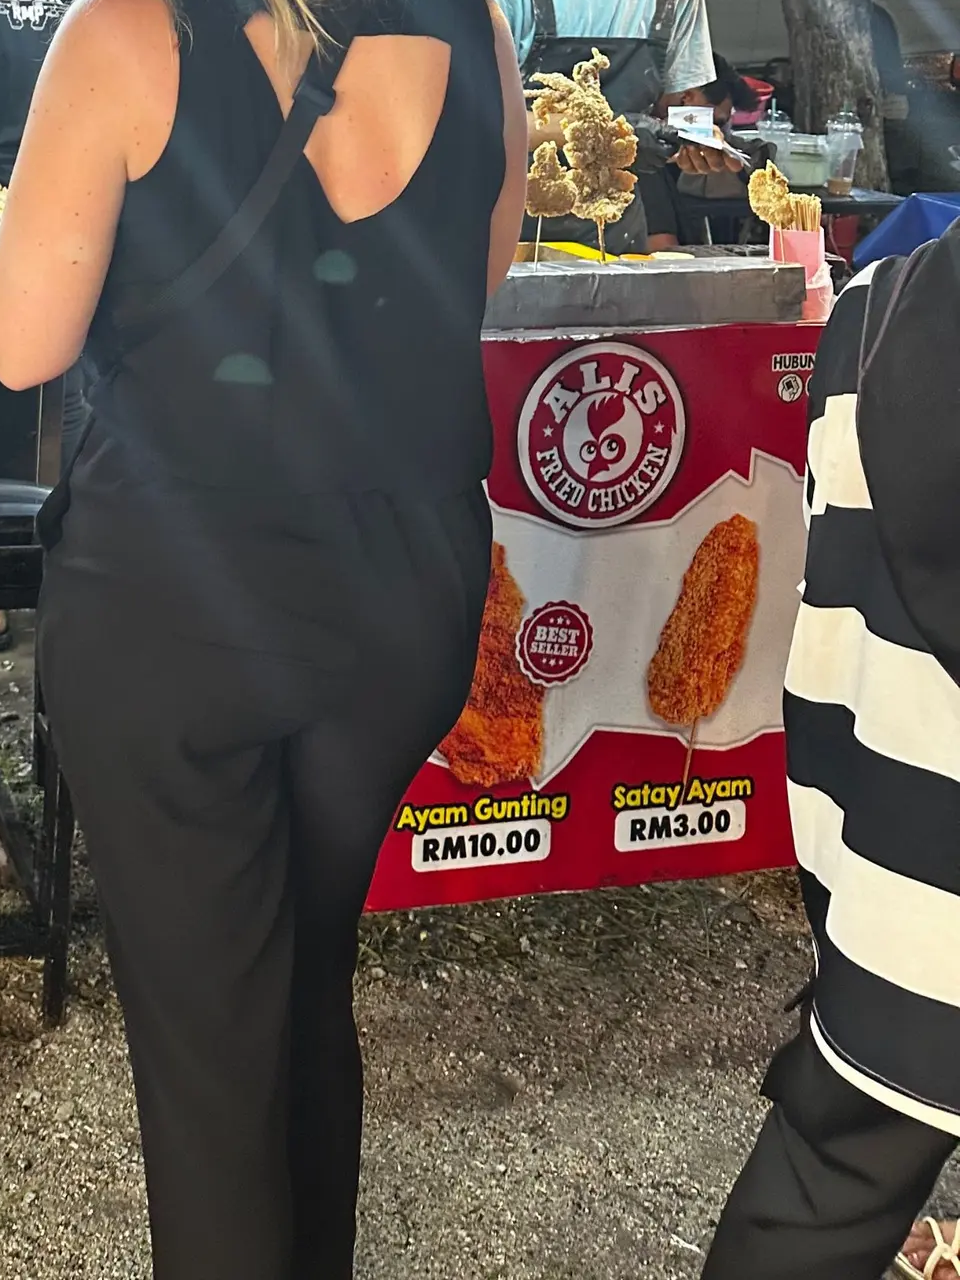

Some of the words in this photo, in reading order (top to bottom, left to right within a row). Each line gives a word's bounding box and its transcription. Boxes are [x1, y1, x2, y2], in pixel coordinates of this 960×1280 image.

[543, 361, 667, 424] ALIS
[536, 445, 587, 508] FRIED
[587, 442, 669, 513] CHICKEN
[529, 638, 581, 659] SELLER
[531, 624, 581, 645] BEST
[613, 783, 682, 808] Satay
[686, 777, 752, 802] Ayam
[396, 803, 468, 832] Ayam
[474, 793, 568, 820] Gunting
[629, 809, 732, 842] RM3.00
[421, 827, 541, 862] RM10.00
